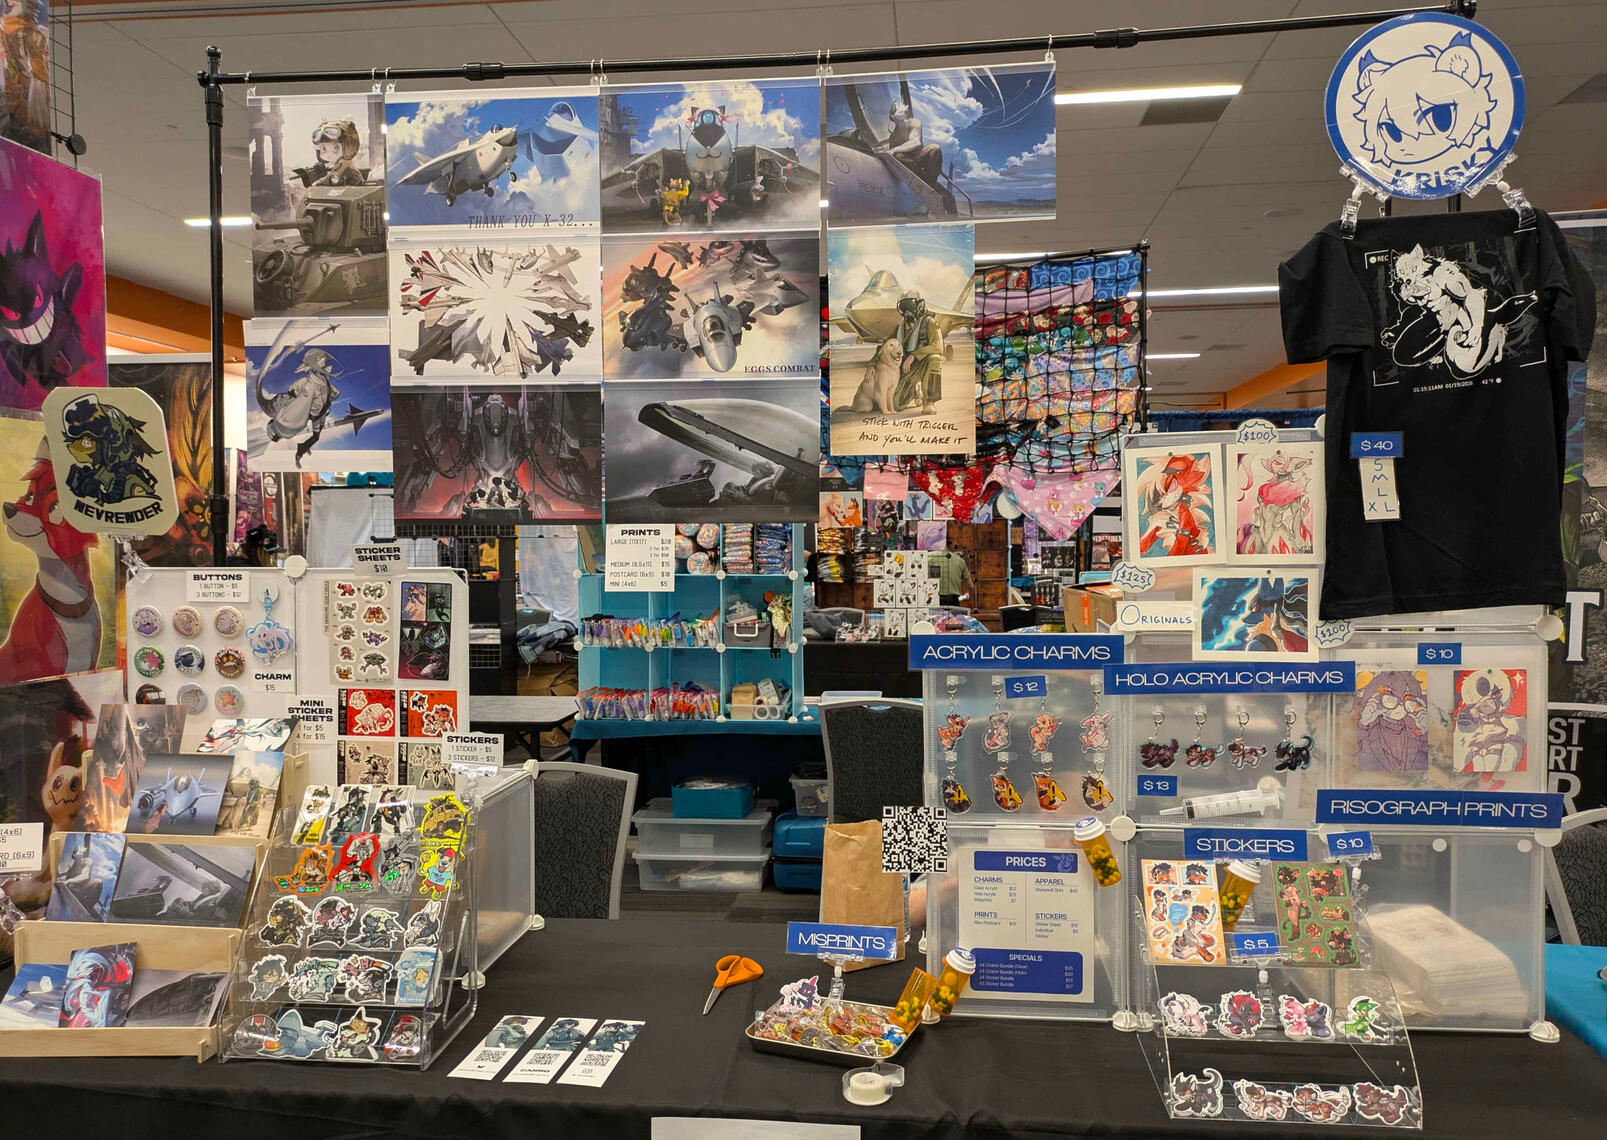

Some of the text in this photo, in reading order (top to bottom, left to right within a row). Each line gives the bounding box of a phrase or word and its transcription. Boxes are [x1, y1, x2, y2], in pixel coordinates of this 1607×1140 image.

[468, 215, 505, 228] THANK
[514, 214, 536, 227] YOU
[744, 364, 815, 373] EGGS COMBAT
[893, 419, 913, 428] WITH
[918, 420, 958, 431] TRIGGER
[859, 432, 878, 441] AND
[953, 437, 967, 445] IT
[1244, 431, 1270, 442] $100
[1374, 459, 1383, 471] S
[1372, 474, 1388, 483] M
[1377, 488, 1388, 496] L
[74, 499, 164, 524] NEVRENDER
[1121, 570, 1146, 583] $125
[1121, 604, 1192, 625] ORIGINALS
[1320, 624, 1346, 638] $100
[923, 645, 1110, 660] ACRYLIC CHARMS
[1115, 670, 1344, 686] HOLO ACRYLIC CHARMS
[447, 736, 499, 744] STICKERS
[1331, 800, 1548, 819] RISOGRAPH PRINTS
[1196, 838, 1295, 853] STICKERS
[1005, 856, 1047, 867] PRICES
[974, 876, 1003, 884] CHARMS
[1035, 878, 1065, 886] APPAREL
[798, 932, 886, 949] MISPRINTS
[1009, 953, 1043, 962] SPECIALS
